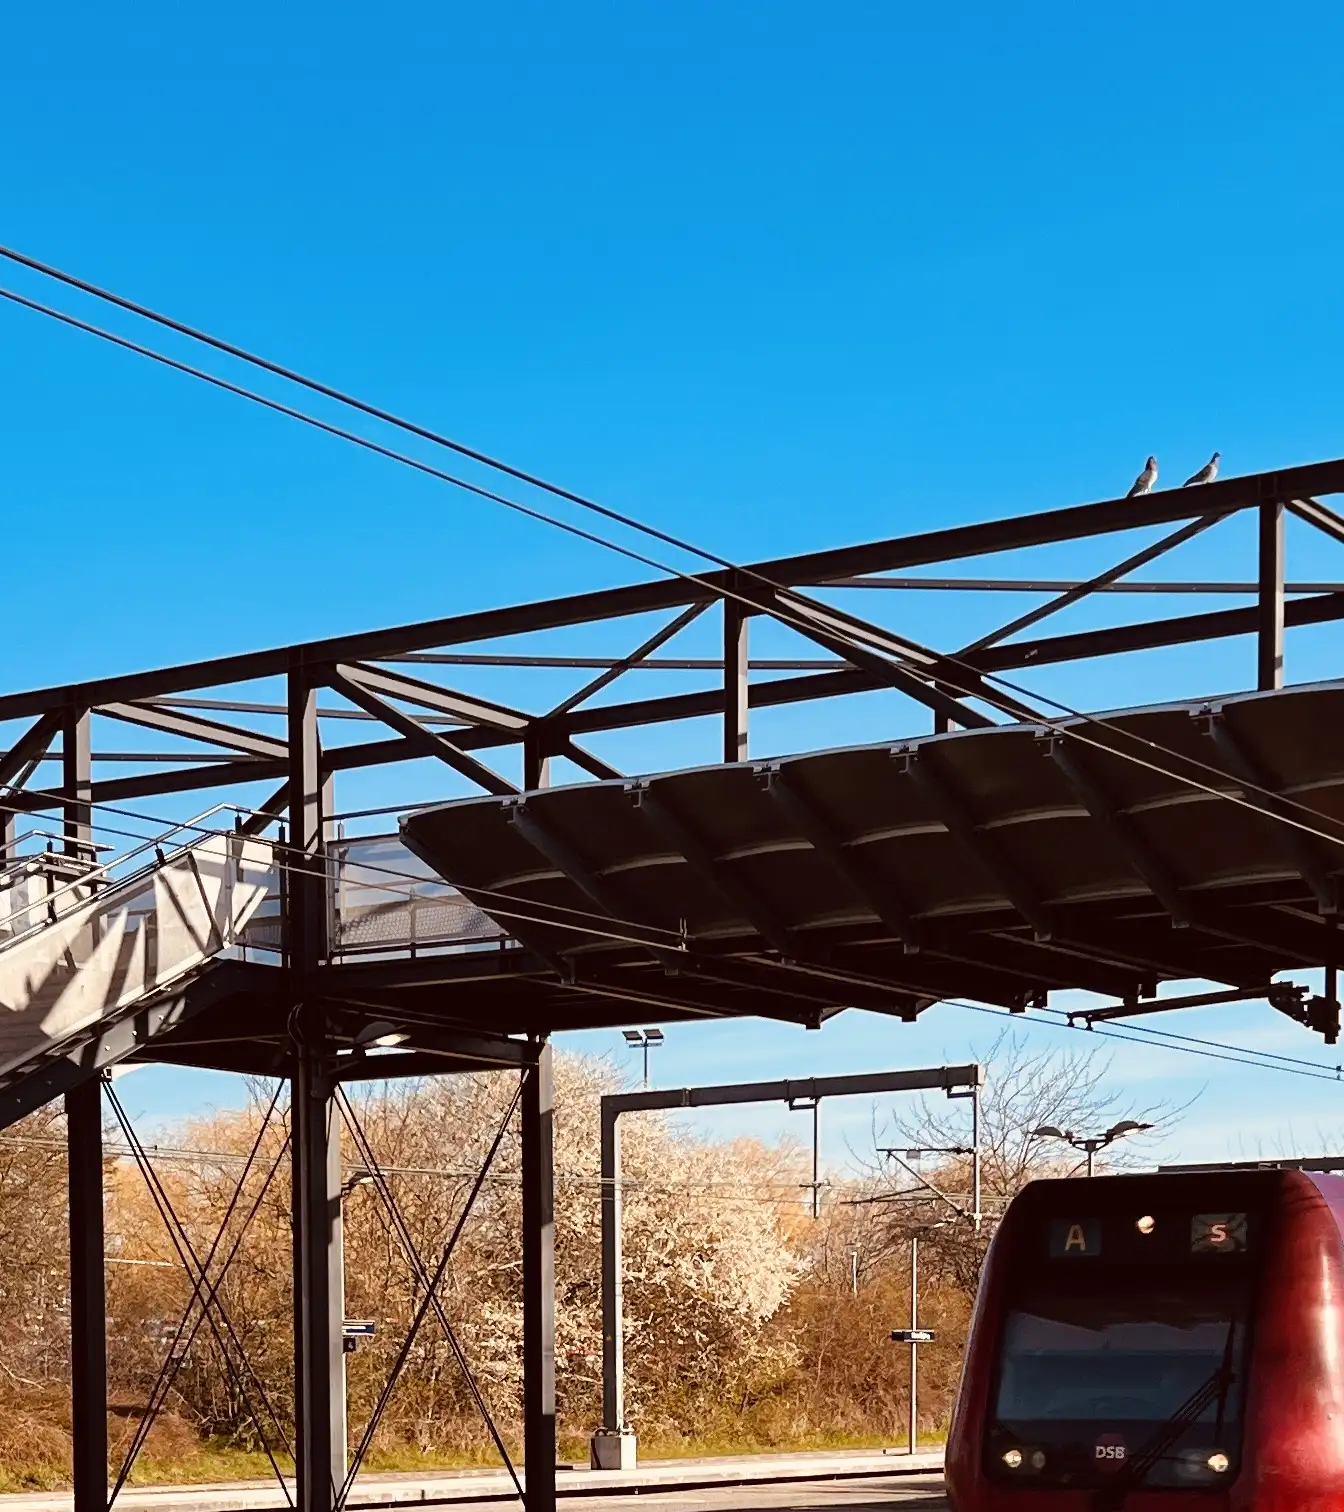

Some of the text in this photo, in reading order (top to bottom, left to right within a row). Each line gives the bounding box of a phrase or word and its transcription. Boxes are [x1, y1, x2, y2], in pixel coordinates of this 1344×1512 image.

[1065, 1224, 1087, 1251] A
[1210, 1224, 1227, 1242] S
[1096, 1446, 1125, 1459] DSB
